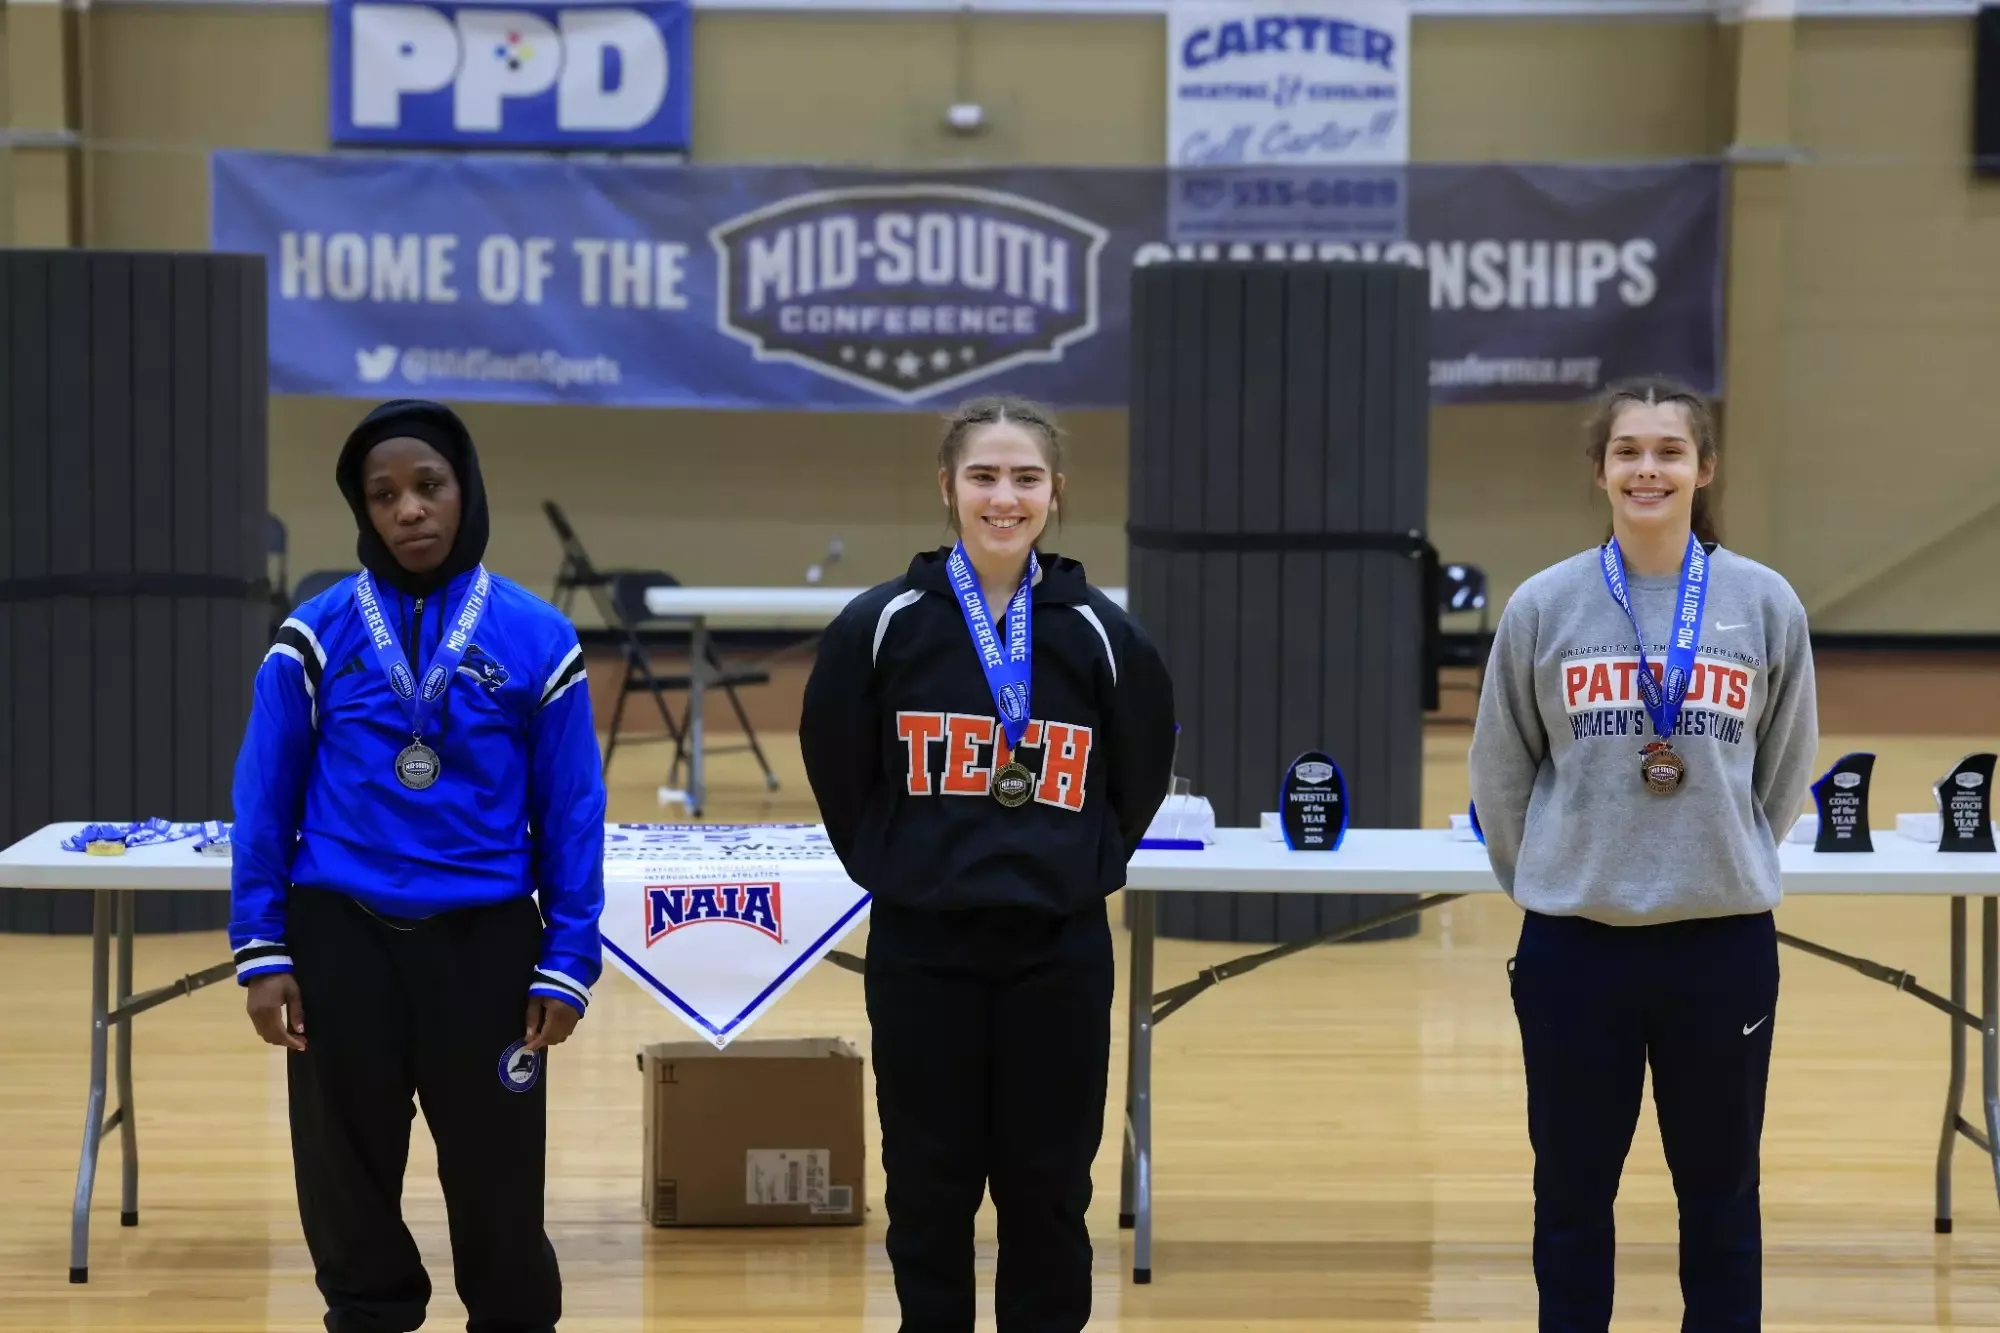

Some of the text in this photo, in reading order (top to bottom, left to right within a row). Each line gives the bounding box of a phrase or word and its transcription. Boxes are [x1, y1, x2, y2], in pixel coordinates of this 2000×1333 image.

[1182, 16, 1395, 71] CARTER
[351, 4, 669, 131] PPD
[280, 232, 690, 310] HOME OF THE
[747, 213, 1069, 314] MID-SOUTH
[779, 305, 1038, 334] CONFERENCE
[1428, 352, 1604, 389] conference.org
[356, 581, 393, 650] CONFERENCE
[446, 593, 484, 653] MID-SOUTH
[963, 591, 1004, 670] CONFERENCE
[1676, 584, 1701, 650] MID-SOUTH
[1560, 643, 1628, 659] UNIVERSITY
[1697, 644, 1761, 666] MBERLANDS
[1569, 710, 1745, 745] WOMEN'S RESTLING
[1289, 793, 1339, 802] WRESTLER
[1303, 804, 1325, 812] of the
[1829, 797, 1860, 806] COACH
[1950, 802, 1982, 810] COACH
[1301, 814, 1326, 823] YEAR
[1831, 816, 1857, 825] YEAR
[1953, 819, 1980, 827] YEAR
[650, 886, 778, 937] NAIA
